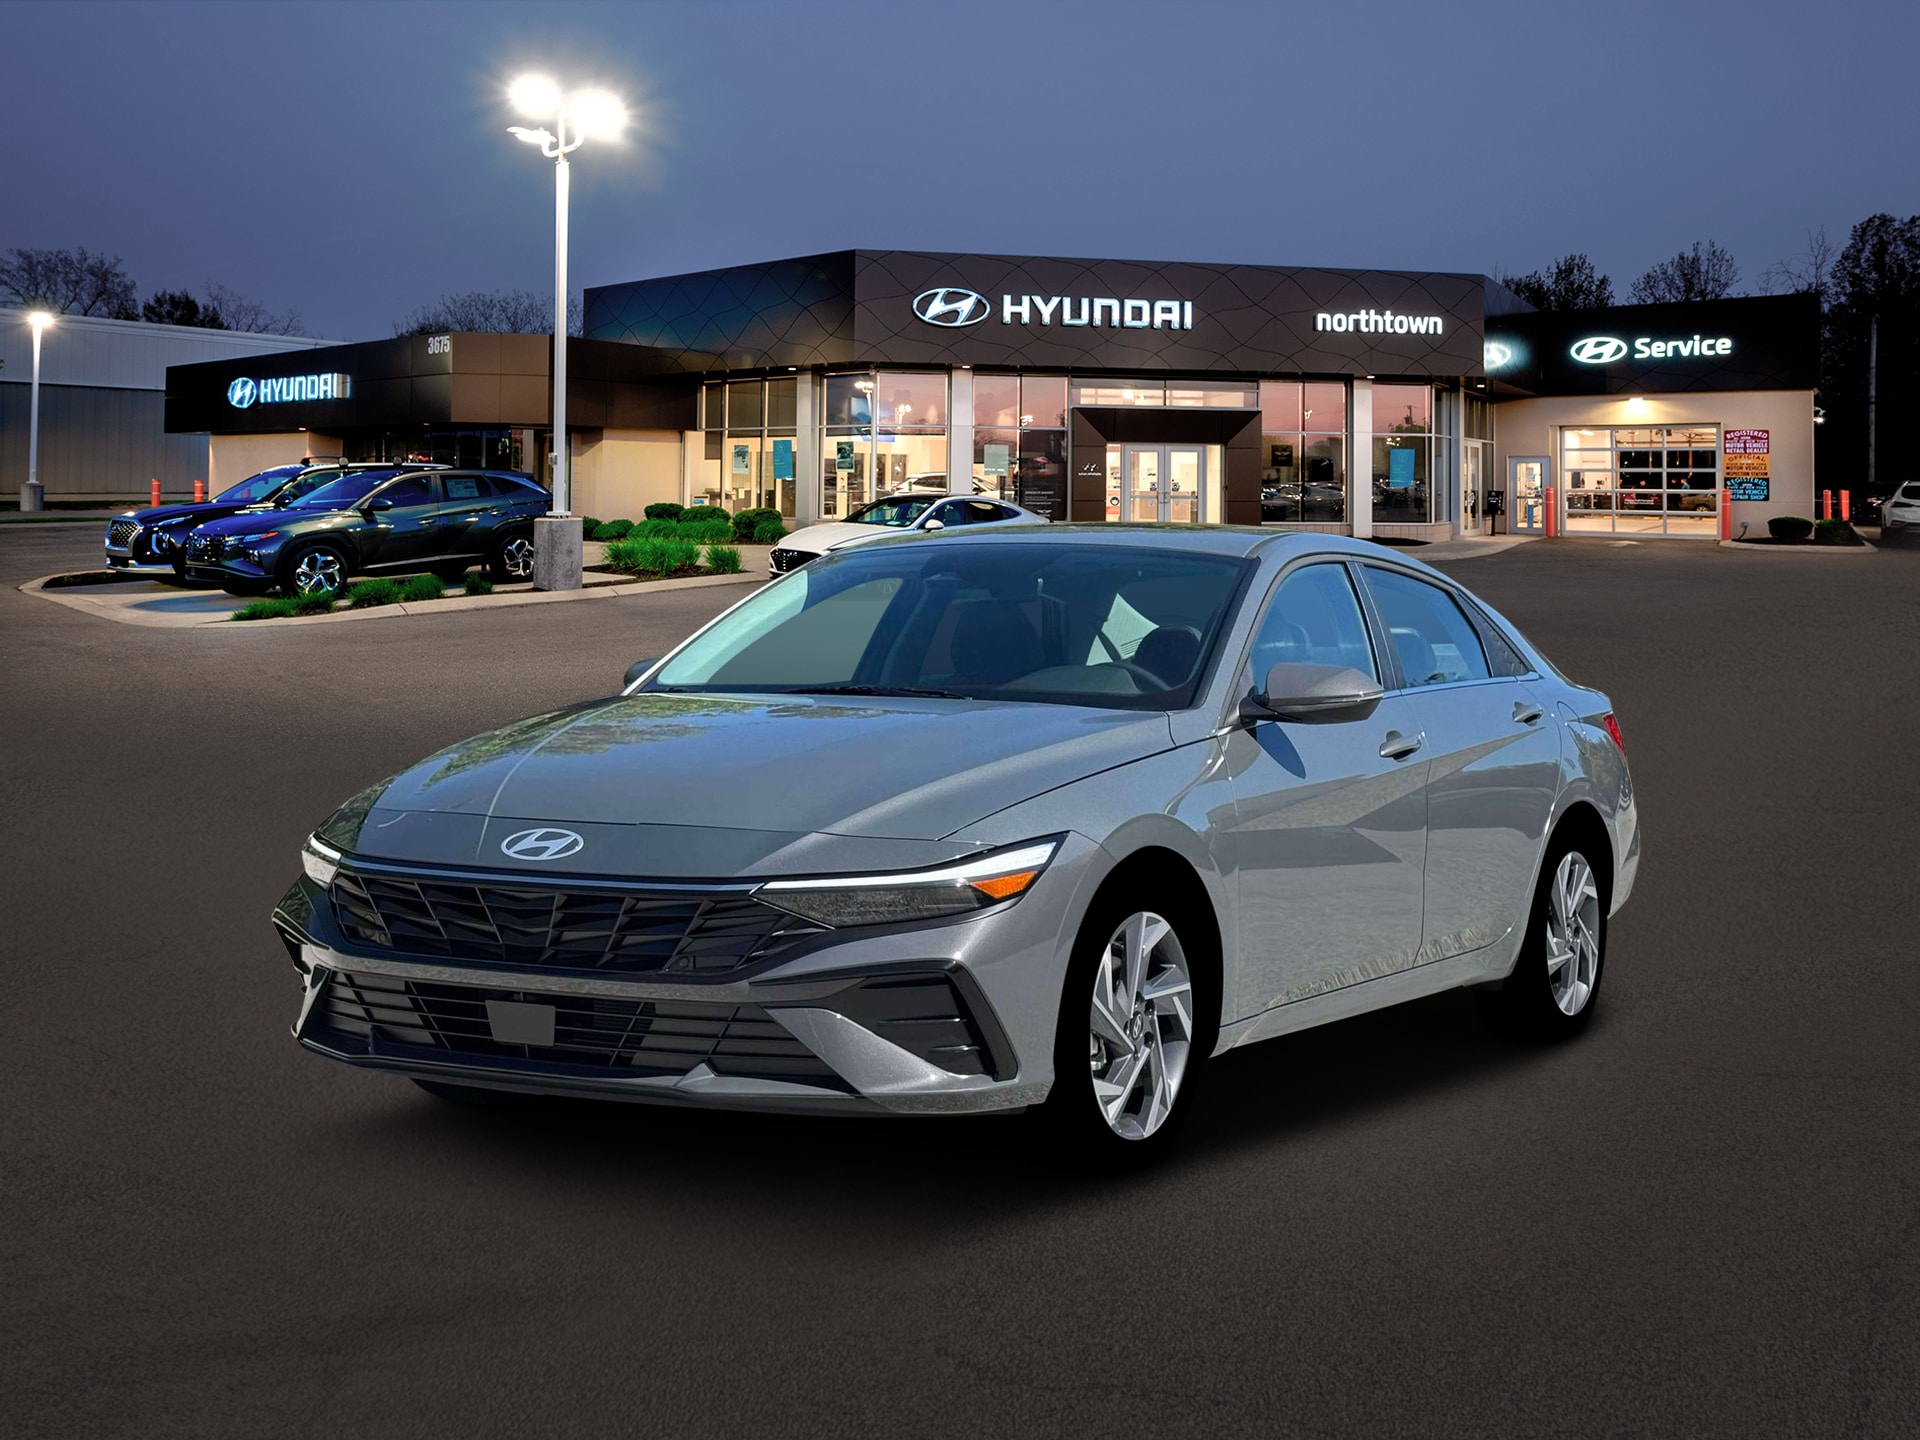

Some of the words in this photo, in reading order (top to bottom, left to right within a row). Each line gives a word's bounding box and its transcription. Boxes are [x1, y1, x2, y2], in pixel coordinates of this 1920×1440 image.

[1002, 294, 1193, 330] HYUNDAI
[1316, 309, 1443, 334] northtown
[428, 335, 450, 354] 3675
[1634, 335, 1732, 358] Service
[260, 373, 338, 403] HYUNDAI
[1725, 430, 1768, 439] REGISTERED
[1726, 477, 1768, 486] REGISTERED
